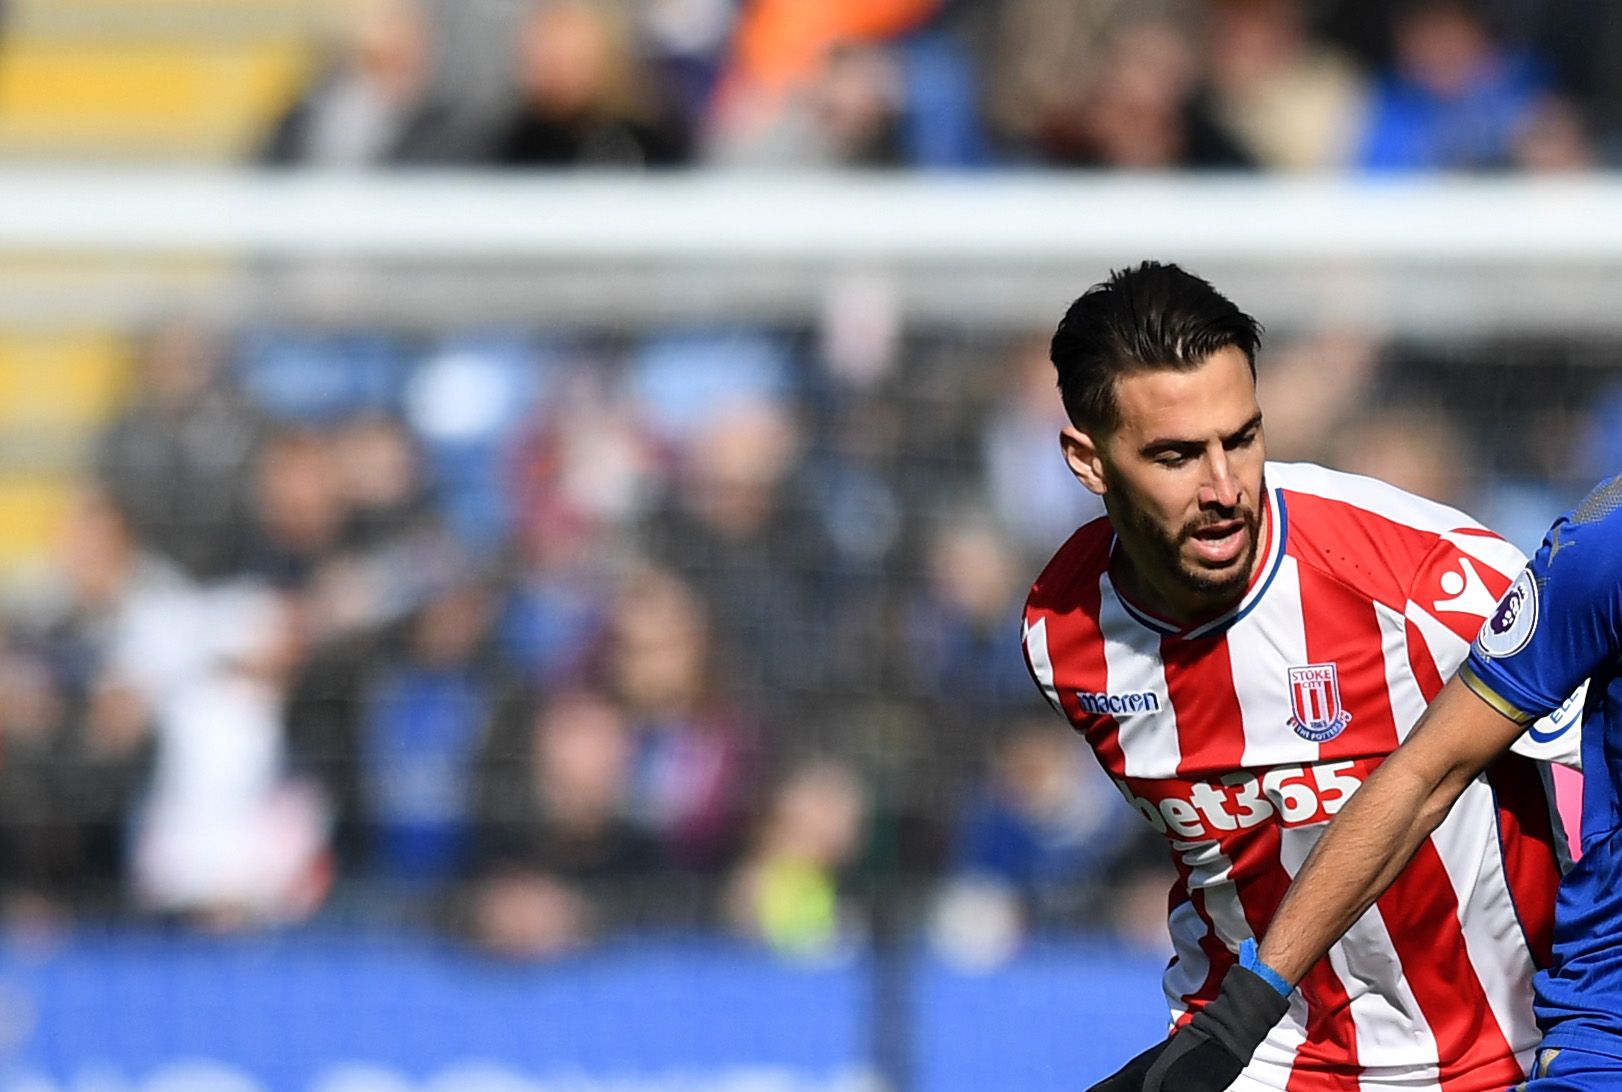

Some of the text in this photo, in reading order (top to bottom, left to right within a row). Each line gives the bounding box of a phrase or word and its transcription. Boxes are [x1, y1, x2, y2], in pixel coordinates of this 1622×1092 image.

[1292, 669, 1331, 681] STOKE
[1302, 681, 1322, 689] CITY
[1078, 691, 1160, 713] macron
[1117, 760, 1362, 837] bet365
